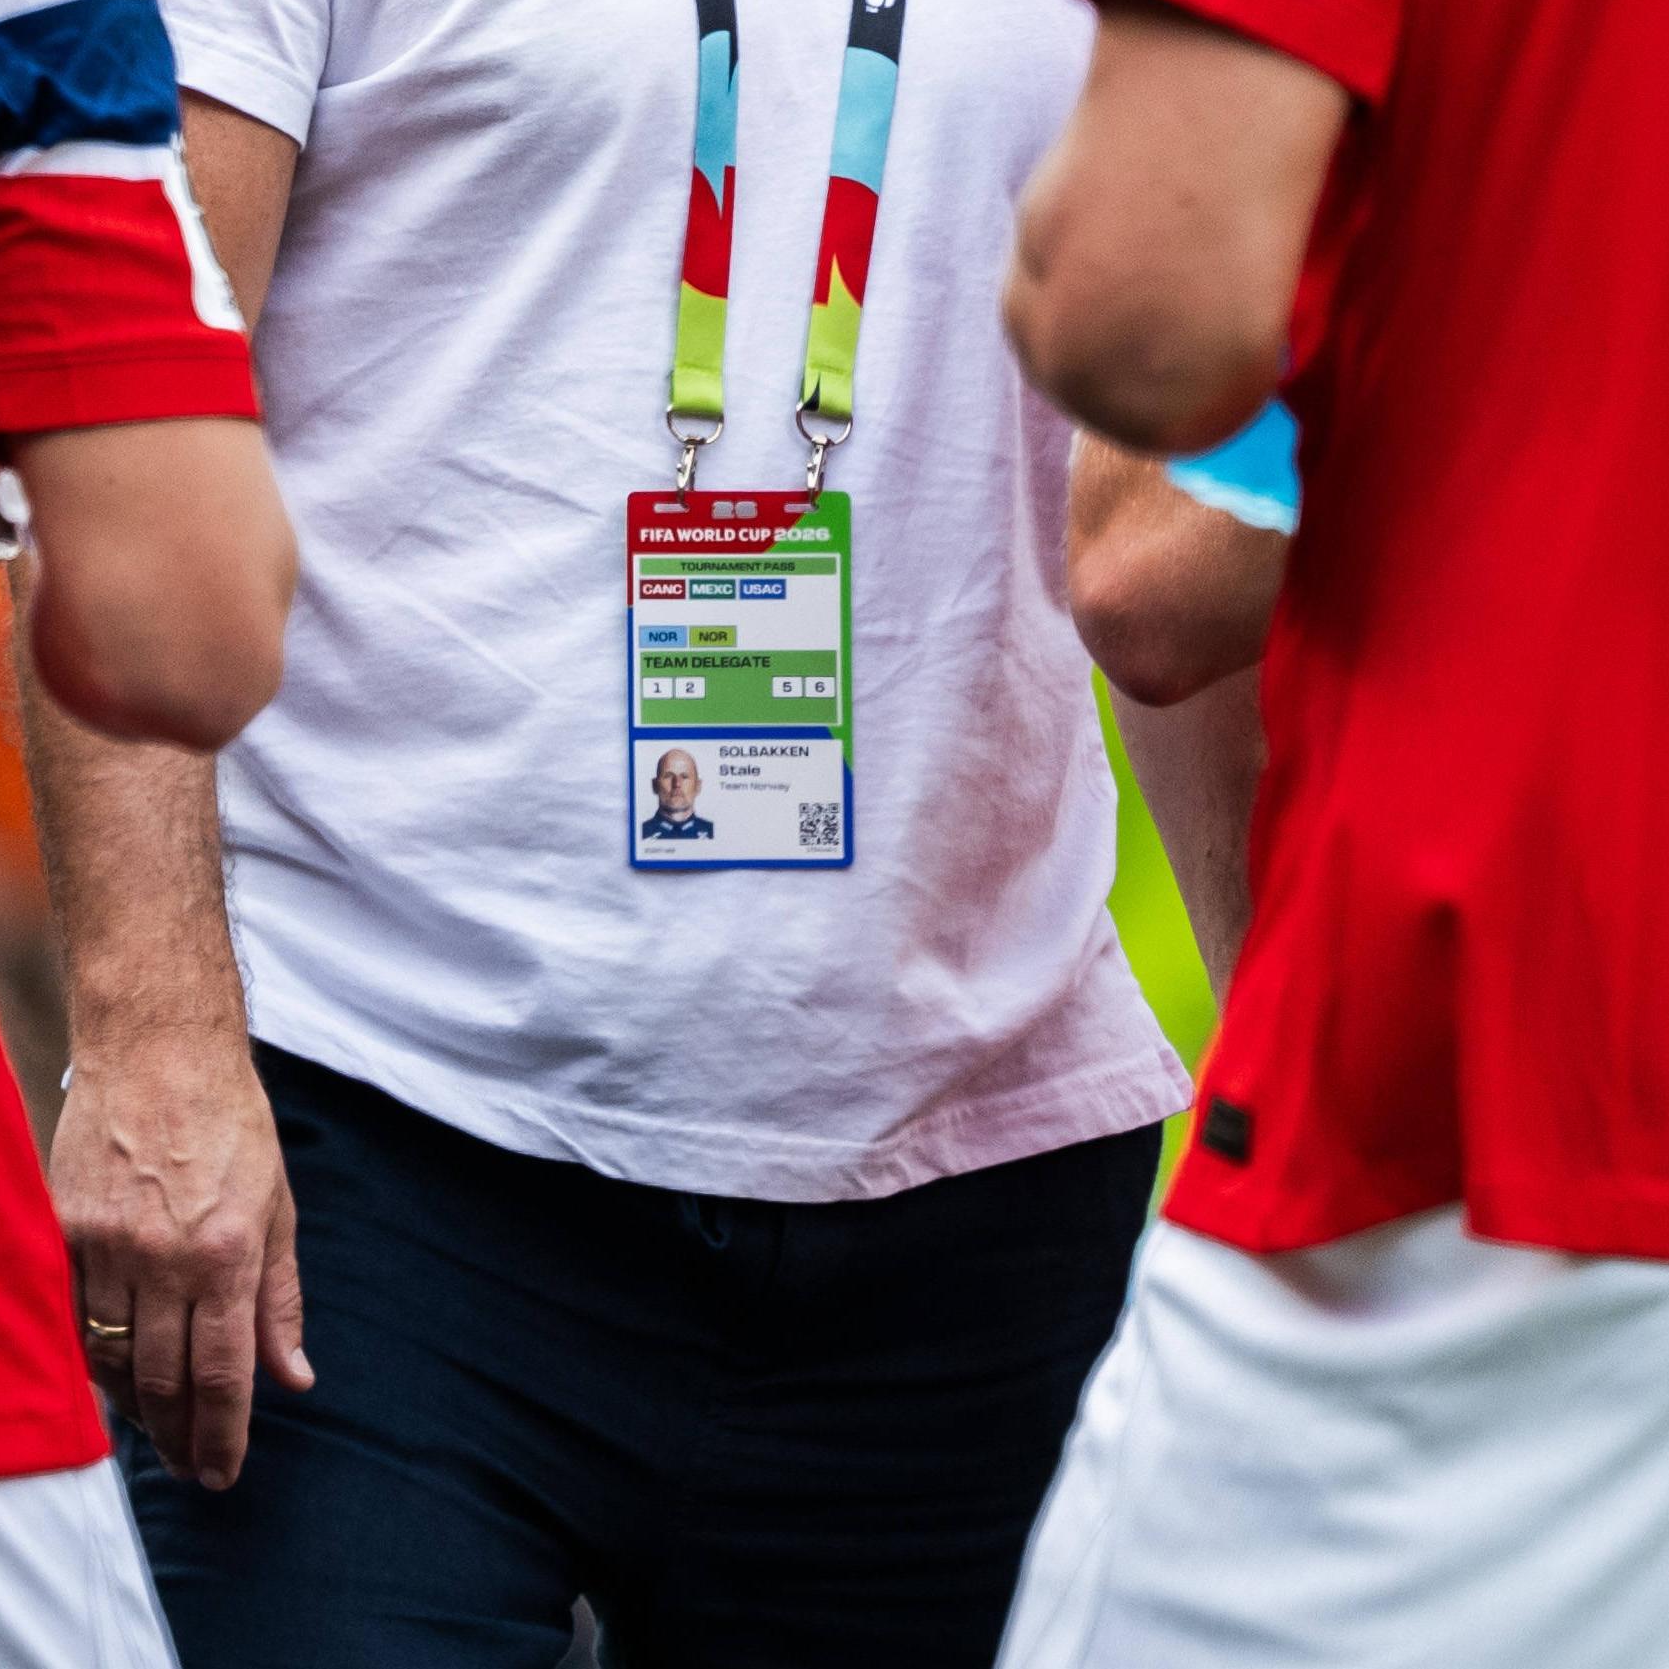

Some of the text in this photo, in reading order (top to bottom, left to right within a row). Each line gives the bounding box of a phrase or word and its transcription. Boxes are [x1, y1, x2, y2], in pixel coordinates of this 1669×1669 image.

[640, 527, 830, 543] FIFA WORLD CUP 2026
[680, 562, 796, 572] TOURNAMENT PASS
[642, 584, 783, 596] CANC MEXC USAC
[648, 631, 728, 643] NOR NOR
[643, 655, 771, 669] TEAM DELEGATE
[653, 681, 825, 694] 1 2 5 6
[719, 745, 810, 758] SOLBAKKEN
